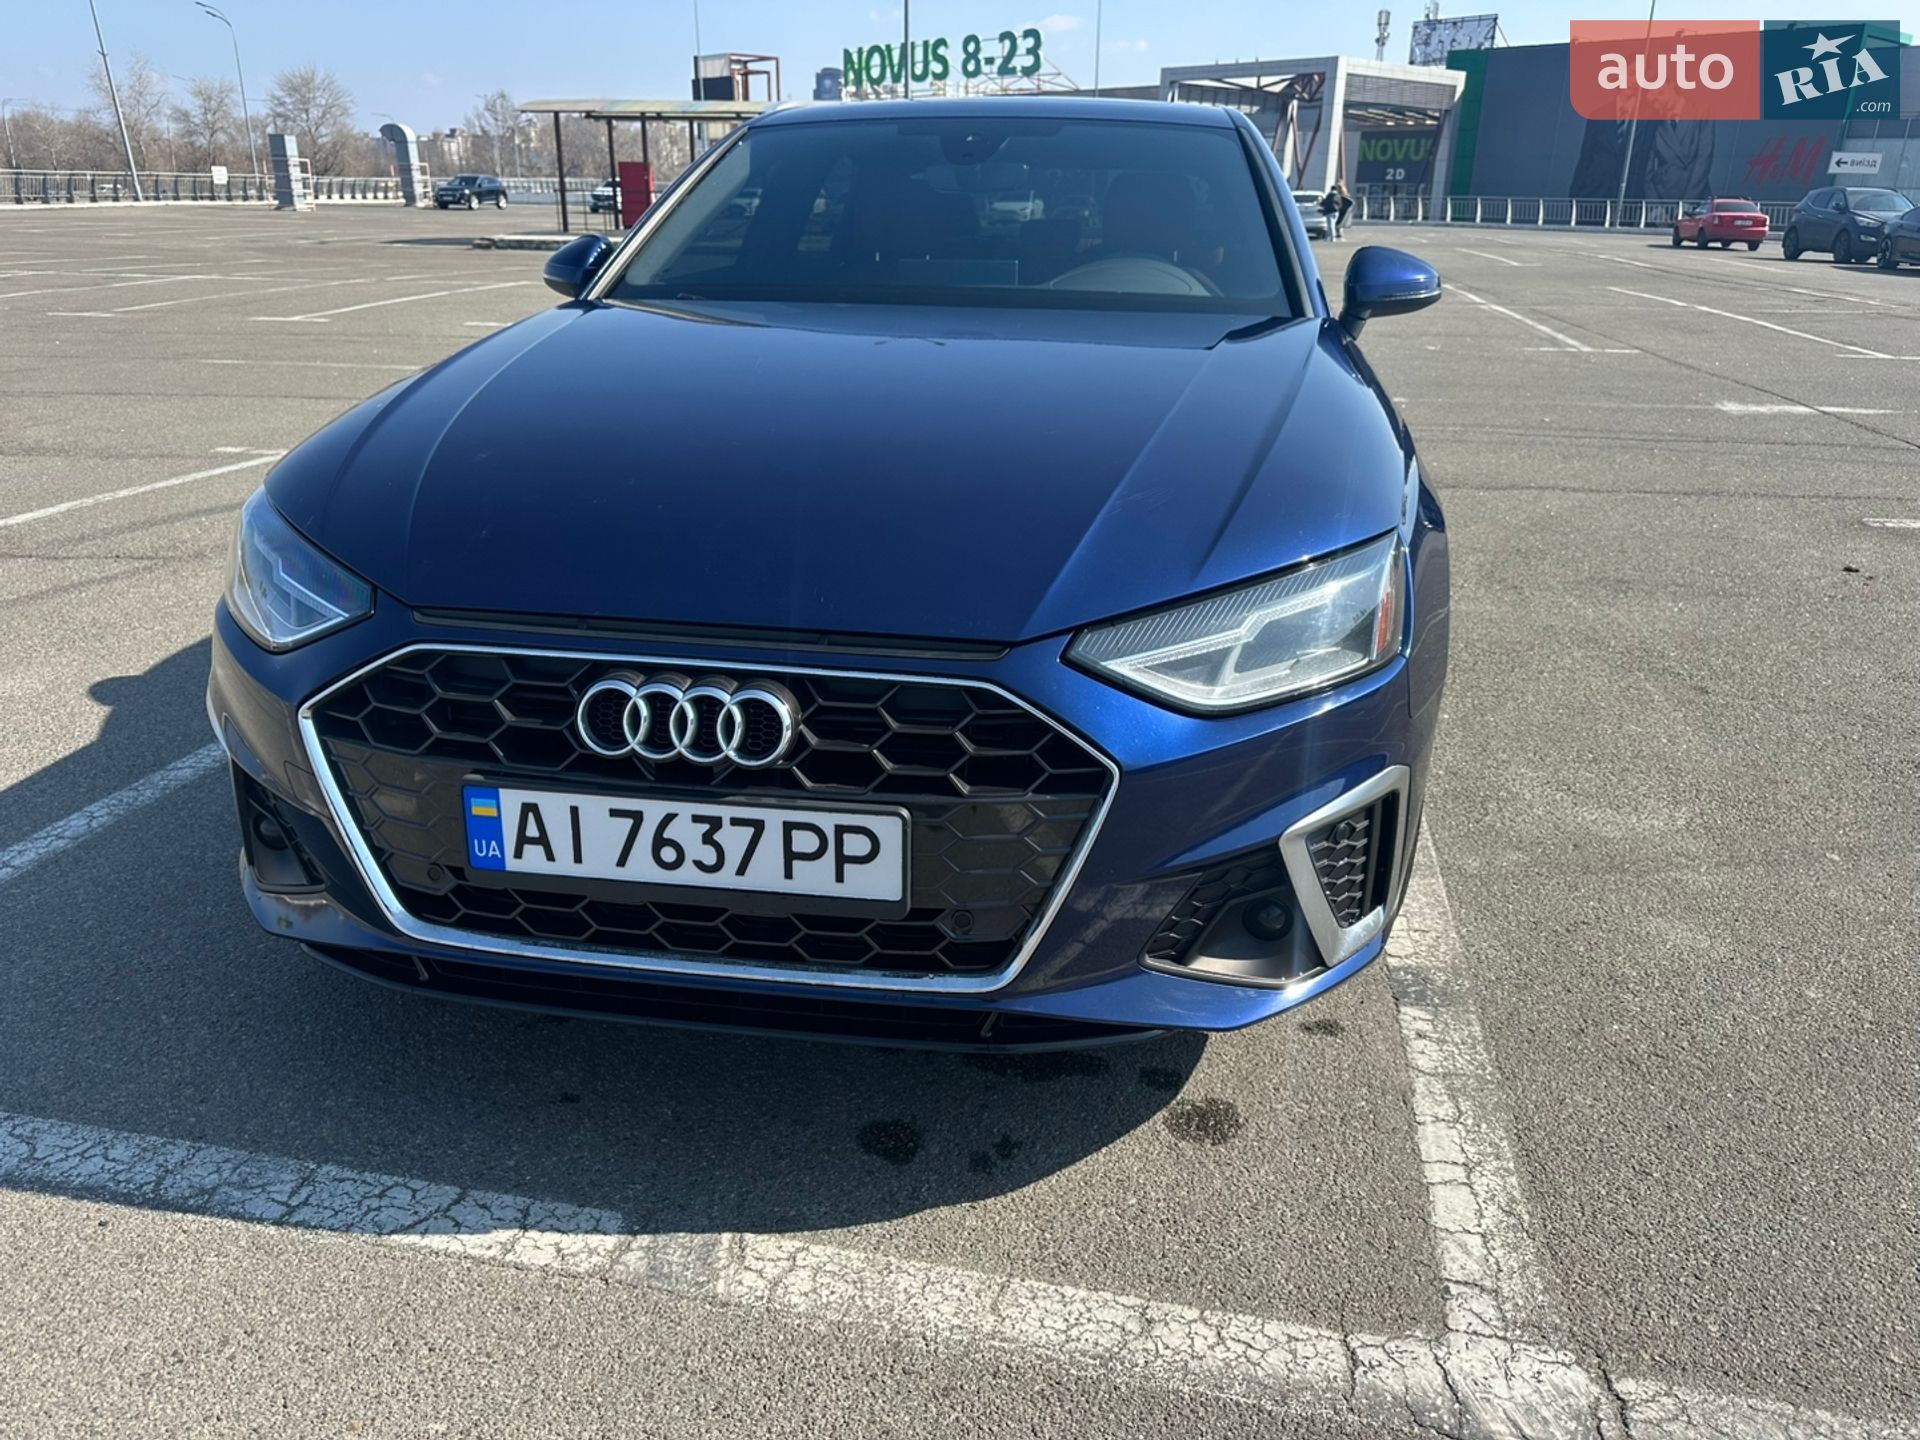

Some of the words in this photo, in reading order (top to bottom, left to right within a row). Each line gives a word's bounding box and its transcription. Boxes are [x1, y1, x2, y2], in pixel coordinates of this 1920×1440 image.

[843, 37, 949, 87] NOVUS
[962, 28, 1042, 78] 8-23
[474, 838, 502, 858] UA
[512, 801, 583, 864] AI
[609, 807, 766, 876] 7637
[782, 819, 881, 884] PP
